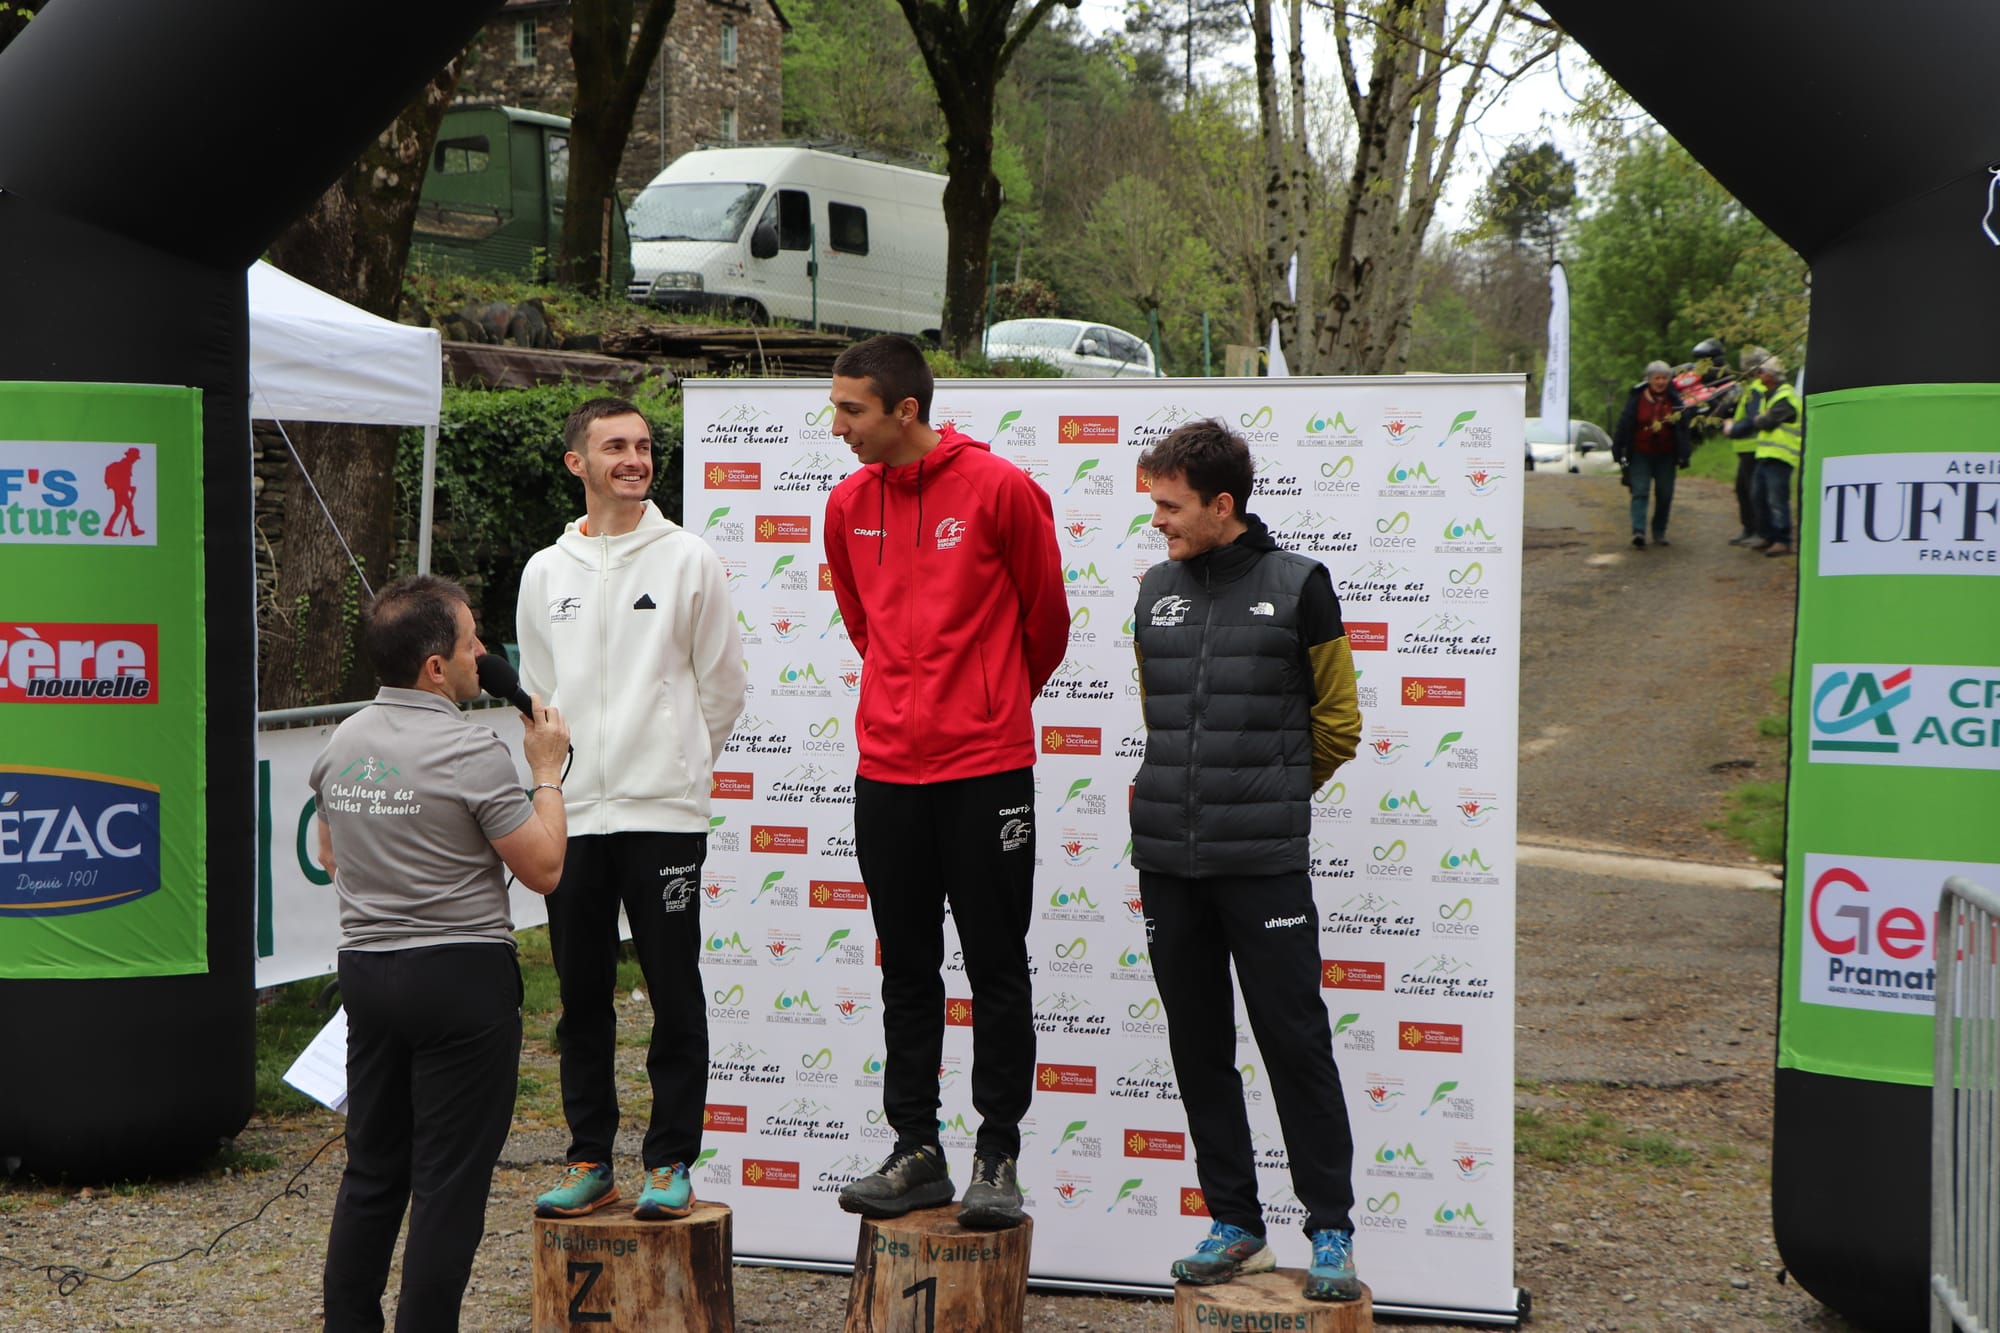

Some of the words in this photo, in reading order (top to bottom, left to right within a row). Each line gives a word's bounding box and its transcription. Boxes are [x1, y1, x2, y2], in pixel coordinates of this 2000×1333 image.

[707, 424, 759, 436] Challenge
[766, 424, 783, 433] des
[701, 435, 738, 444] vallées
[744, 435, 789, 444] cévenoles
[780, 472, 833, 484] Challenge
[1277, 476, 1296, 485] des
[774, 483, 811, 492] vallées
[1253, 486, 1302, 496] cévenoles
[1314, 479, 1360, 492] lozère
[854, 528, 881, 537] CRAFT
[1332, 531, 1352, 540] des
[1308, 542, 1358, 552] cévenoles
[1370, 535, 1416, 548] lozère
[1919, 549, 1997, 562] FRANCE
[1338, 580, 1397, 593] Challenge
[1405, 581, 1424, 591] des
[1442, 586, 1489, 599] lozère
[1337, 592, 1372, 603] allées
[1380, 593, 1430, 603] cévenoles
[1404, 633, 1464, 646] Challenge
[1471, 634, 1490, 644] des
[1397, 644, 1438, 655] vallées
[1446, 645, 1497, 656] cévenoles
[27, 675, 150, 698] nouvelle
[1090, 679, 1109, 688] des
[1066, 690, 1114, 700] cévenoles
[769, 734, 787, 743] des
[802, 739, 845, 751] lozère
[747, 744, 792, 754] cévenoles
[1115, 748, 1144, 757] vallé
[331, 783, 387, 804] Challenge
[394, 788, 414, 801] des
[773, 782, 827, 795] Challenge
[833, 785, 851, 793] des
[767, 793, 803, 803] vallées
[810, 794, 857, 804] cévenoles
[329, 799, 361, 813] vallées
[369, 802, 421, 815] cévenoles
[999, 807, 1025, 816] CRAFT
[1311, 806, 1352, 819] ozère
[1329, 858, 1348, 867] des
[660, 863, 696, 876] uhlsport
[1366, 863, 1413, 876] lozère
[16, 874, 63, 895] Depuis
[66, 870, 99, 888] 1901
[1264, 914, 1307, 929] uhlsport
[1329, 912, 1388, 926] Challenge
[1395, 915, 1415, 925] des
[1322, 924, 1362, 934] vallées
[1370, 925, 1420, 937] cévenoles
[1432, 921, 1479, 935] lozère
[1049, 960, 1093, 974] lozère
[1348, 972, 1382, 980] Occitanie
[1401, 973, 1461, 988] Challenge
[1468, 978, 1488, 987] des
[1394, 986, 1435, 996] vallées
[1443, 987, 1494, 999] cévenoles
[708, 1006, 750, 1019] lozère
[1034, 1012, 1080, 1024] hallenge
[1086, 1014, 1105, 1024] des
[1063, 1024, 1111, 1035] cévenoles
[1122, 1021, 1167, 1034] lozère
[1425, 1034, 1460, 1043] Occitanie
[708, 1060, 756, 1073] hallenge
[762, 1064, 780, 1073] des
[740, 1074, 785, 1084] cévenoles
[796, 1071, 838, 1084] lozère
[1117, 1077, 1173, 1090] Challenge
[1110, 1089, 1149, 1099] vallées
[766, 1116, 824, 1130] Challenge
[826, 1120, 844, 1129] des
[760, 1128, 797, 1137] vallées
[804, 1130, 850, 1140] cévenoles
[1266, 1149, 1285, 1158] des
[1360, 1214, 1407, 1228] lozère
[543, 1231, 638, 1257] Challenge
[872, 1233, 912, 1258] Des
[927, 1243, 1001, 1263] Vallées
[902, 1277, 937, 1333] 1
[1196, 1303, 1305, 1331] Cévenoles
